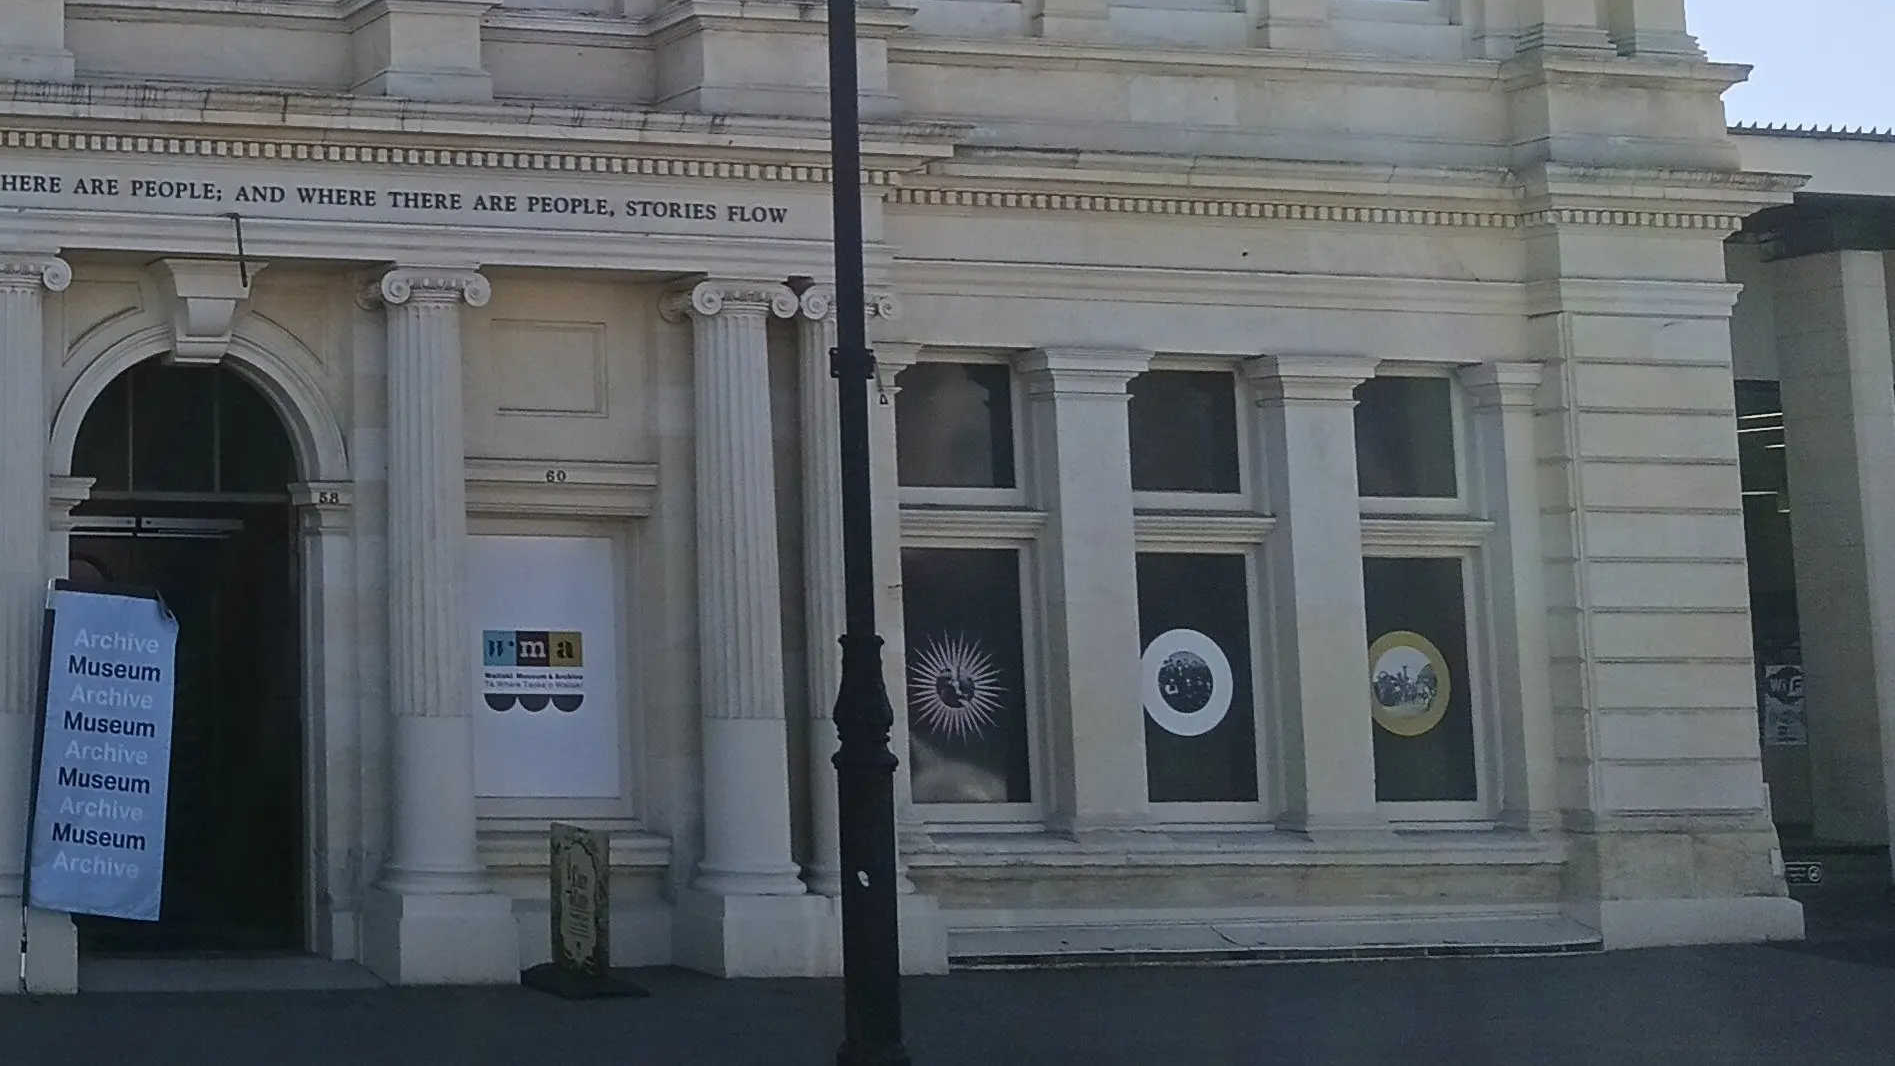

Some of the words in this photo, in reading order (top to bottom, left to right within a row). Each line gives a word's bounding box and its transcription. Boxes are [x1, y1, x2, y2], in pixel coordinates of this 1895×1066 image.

[74, 179, 118, 195] ARE
[131, 180, 221, 201] PEOPLE;
[236, 186, 285, 202] AND
[297, 188, 376, 206] WHERE
[388, 192, 462, 209] THERE
[473, 196, 516, 212] ARE
[528, 197, 614, 217] PEOPLE,
[626, 201, 716, 220] STORIES
[728, 206, 787, 223] FLOW
[547, 470, 566, 482] 60
[320, 492, 338, 504] 58
[74, 629, 159, 653] Archive
[69, 655, 160, 682] Museum
[69, 684, 152, 709] Archive
[65, 711, 154, 737] Museum
[65, 740, 148, 765] Archive
[59, 767, 149, 794] Museum
[60, 796, 143, 822] Archive
[53, 823, 145, 850] Museum
[53, 851, 140, 879] Archive
